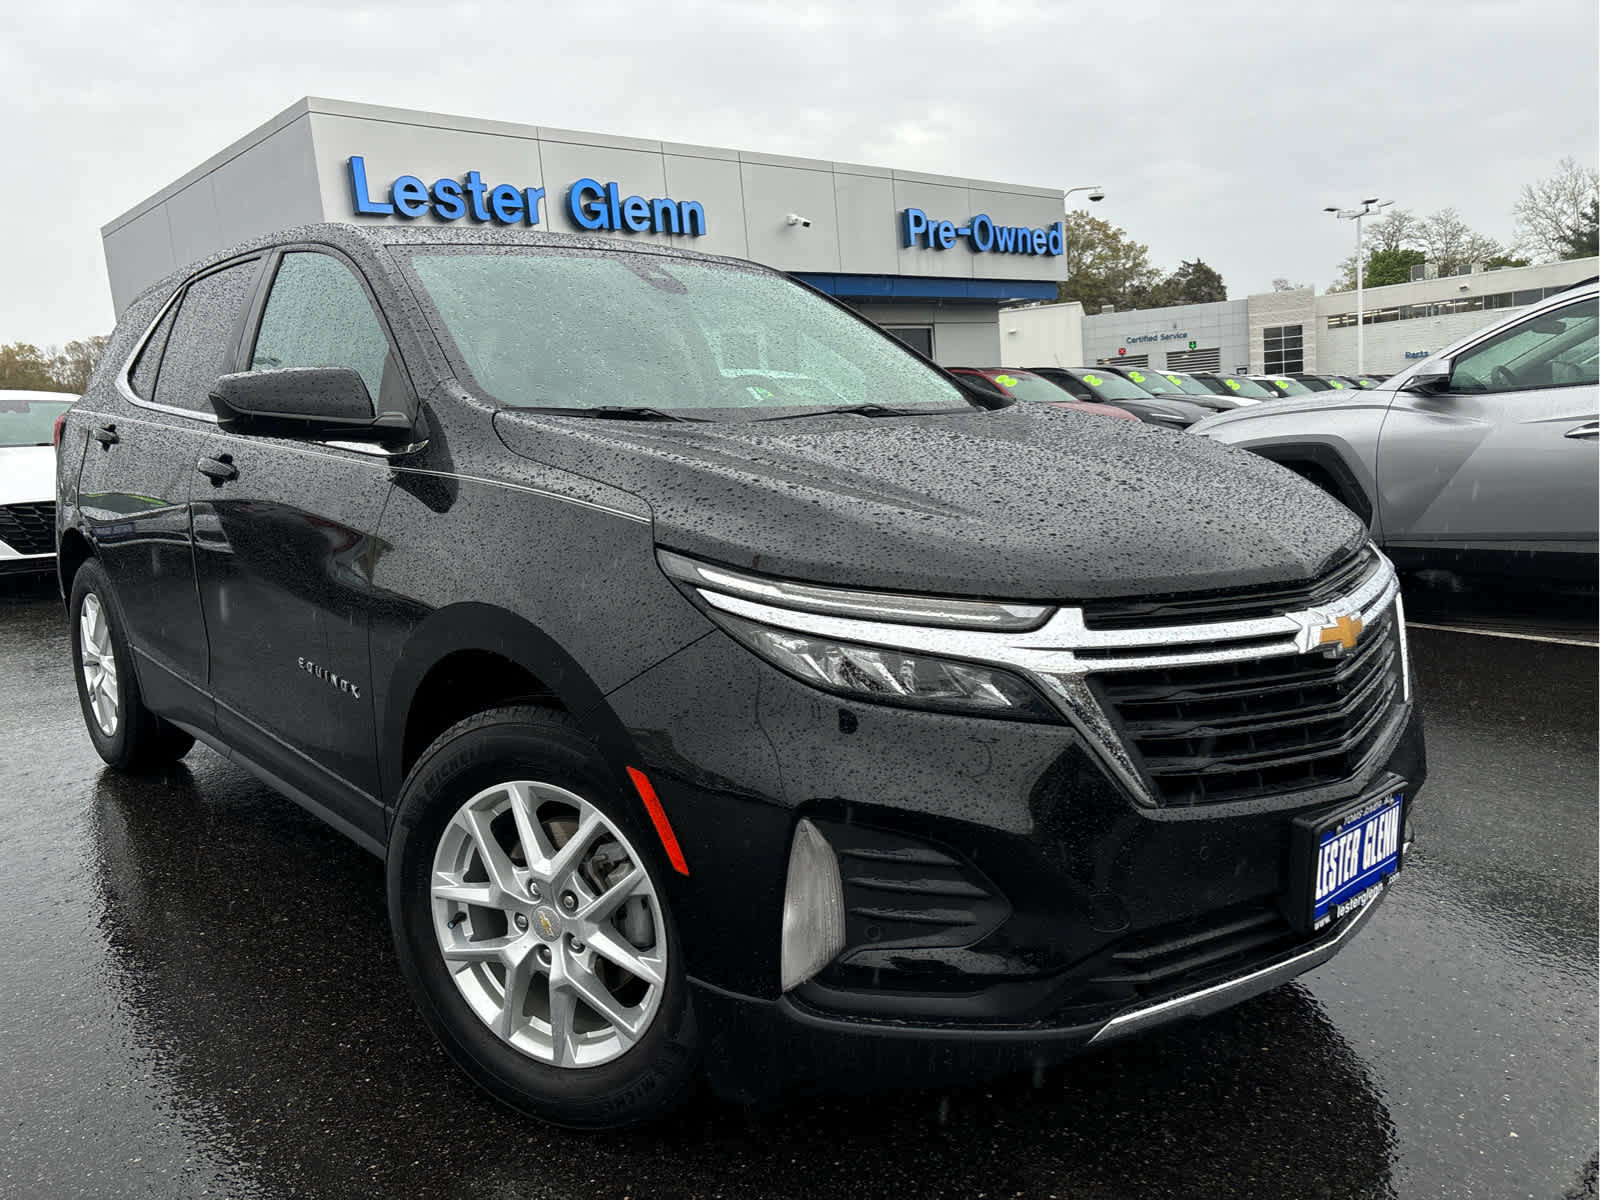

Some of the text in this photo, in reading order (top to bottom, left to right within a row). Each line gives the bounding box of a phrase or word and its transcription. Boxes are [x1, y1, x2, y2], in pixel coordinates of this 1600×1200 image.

[346, 156, 706, 236] Lester Glenn
[903, 207, 1064, 256] Pre-Owned
[1126, 331, 1188, 345] Certified Service
[1405, 350, 1429, 360] Parts
[297, 656, 360, 699] EQUINOX
[1315, 805, 1399, 900] LESTER GLENN
